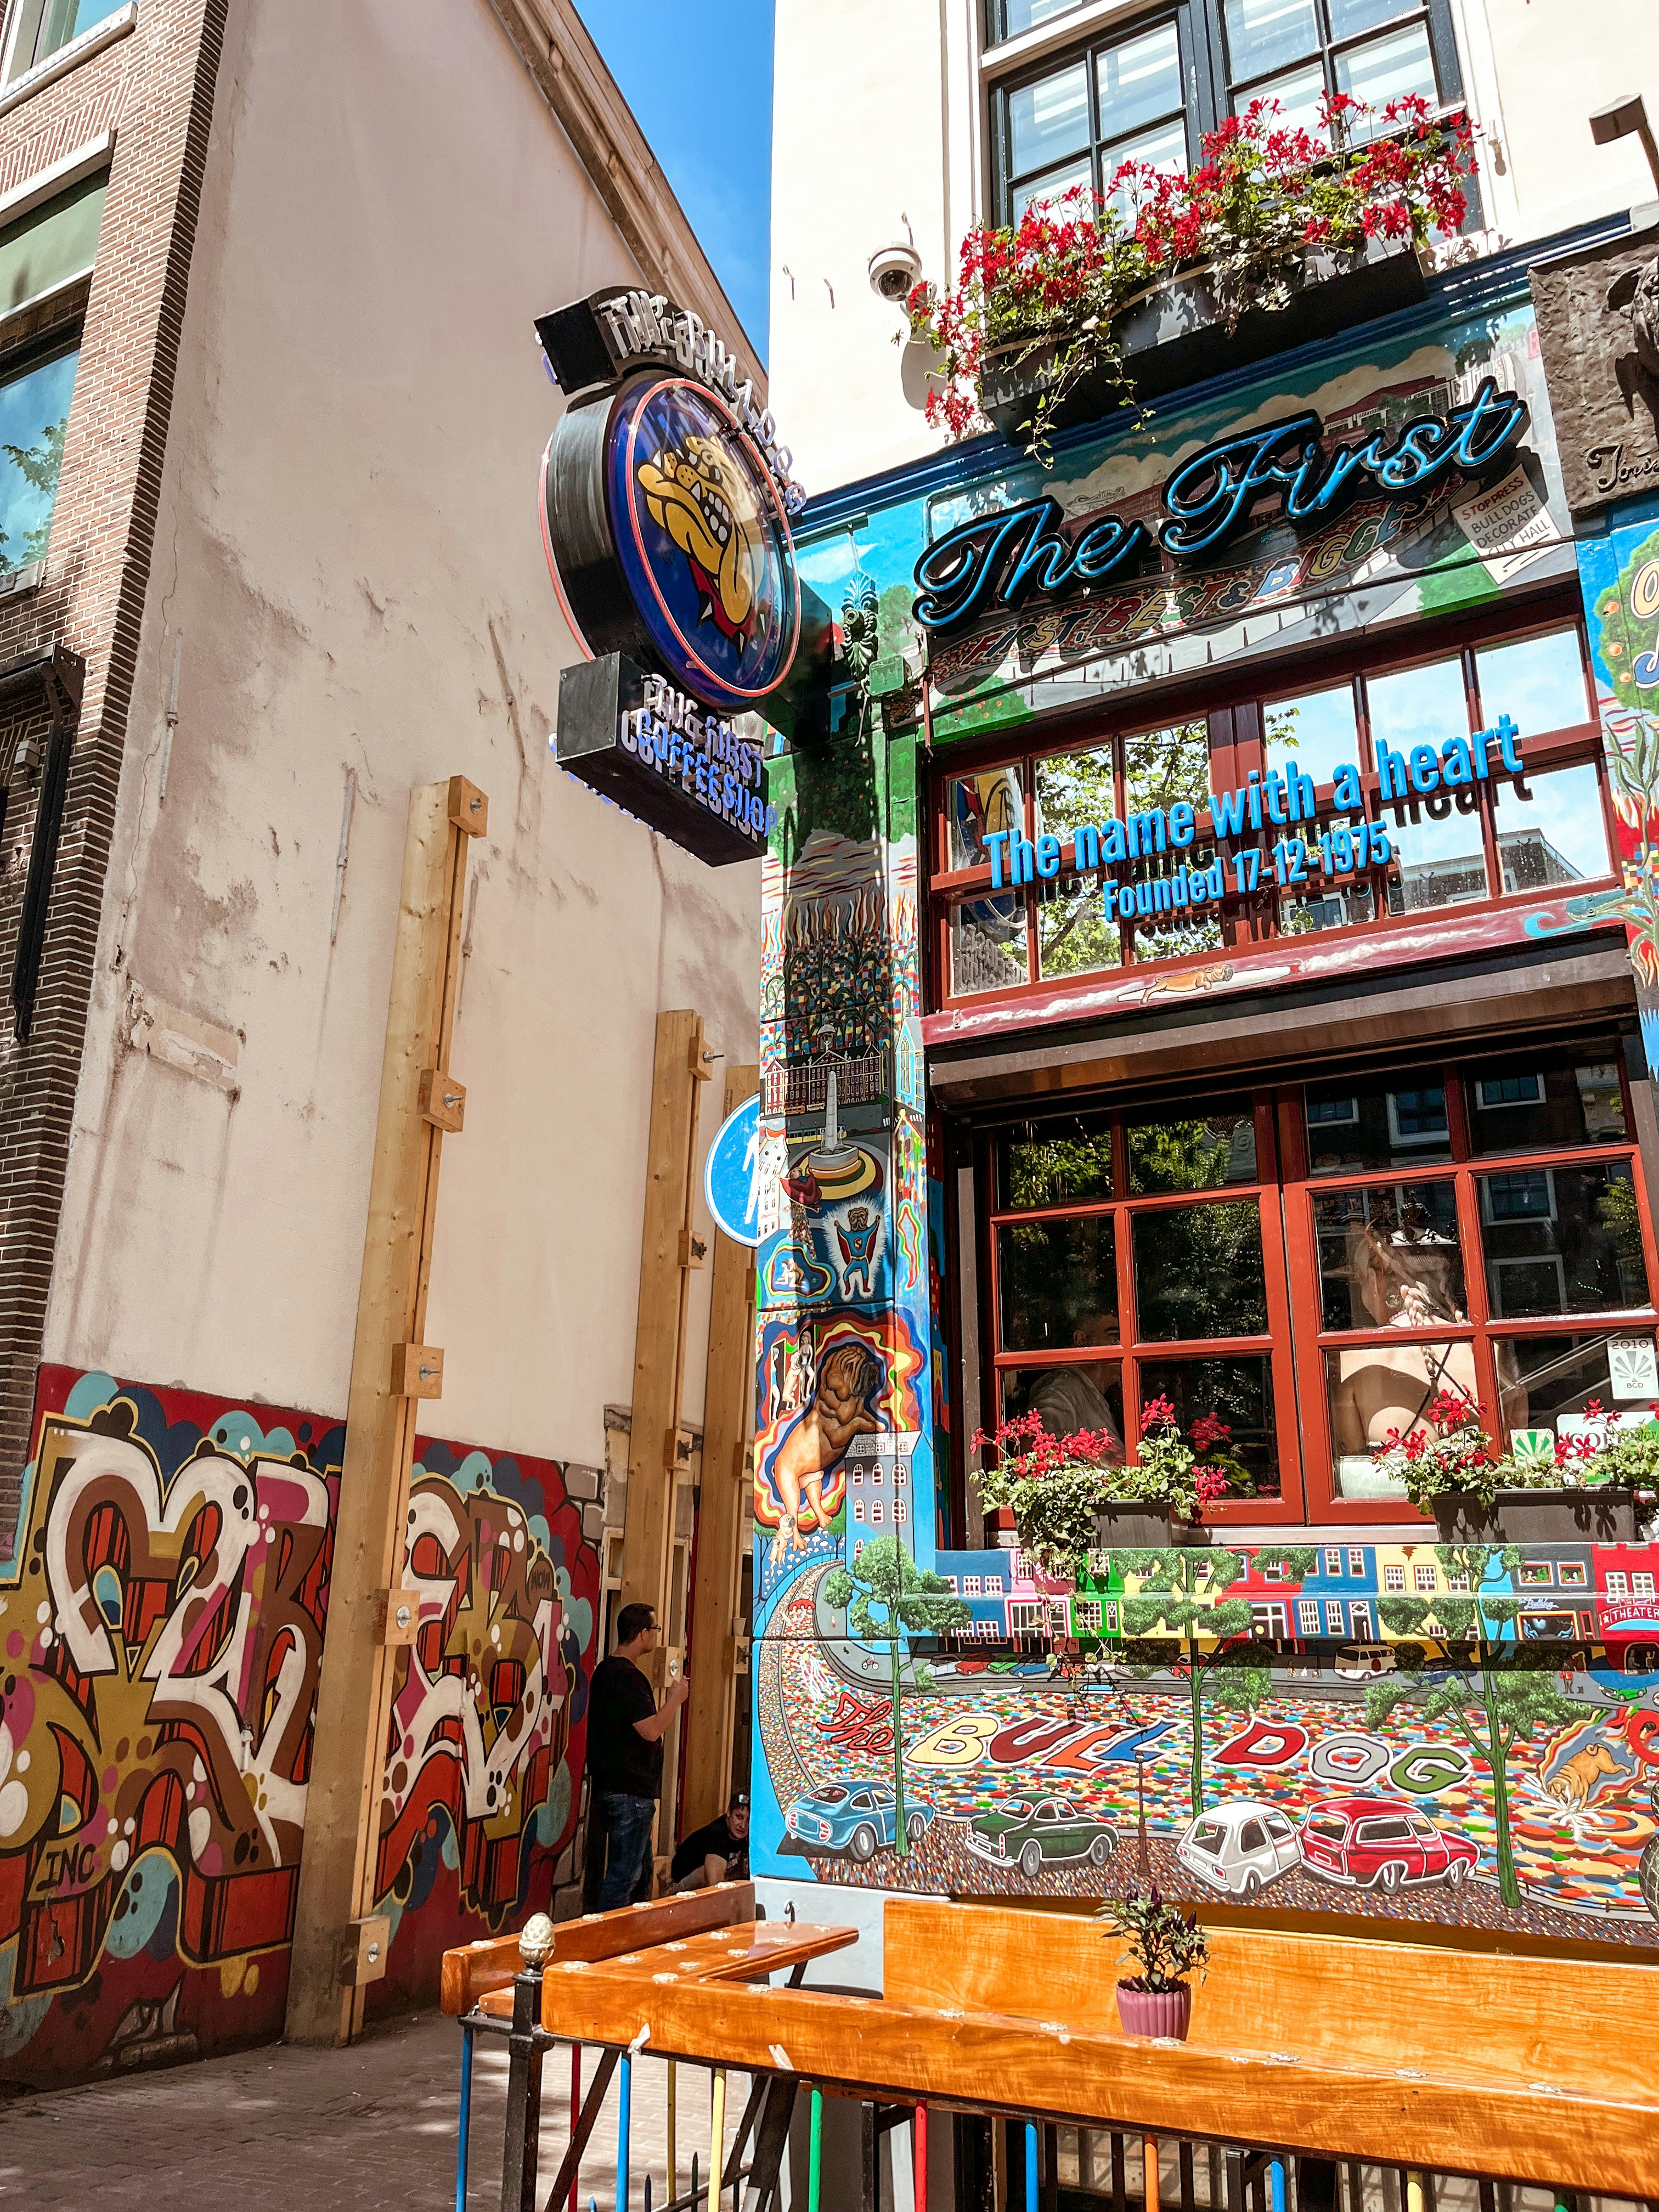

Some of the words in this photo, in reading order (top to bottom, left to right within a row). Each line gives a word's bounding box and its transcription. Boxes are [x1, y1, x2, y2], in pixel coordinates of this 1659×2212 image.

[914, 498, 1147, 630] The
[1160, 380, 1528, 553] First
[1461, 499, 1491, 521] STOP
[1492, 476, 1524, 504] PRESS
[1476, 505, 1537, 548] DECORATE
[1519, 520, 1550, 543] HALL
[1090, 580, 1233, 637] BEST
[1218, 580, 1251, 608] &
[622, 707, 777, 843] COFFEESHOP
[704, 715, 764, 788] FIRST
[982, 828, 1060, 889] The
[1074, 802, 1195, 870] name
[1207, 761, 1315, 838] with
[1333, 763, 1362, 811] a
[1375, 714, 1524, 800] heart
[1103, 856, 1225, 921] Founded
[1232, 820, 1390, 894] 17-12-1975
[1612, 1339, 1649, 1350] 2010
[816, 1692, 911, 1755] The
[902, 1712, 1188, 1776] BULL
[1207, 1717, 1474, 1798] DOG
